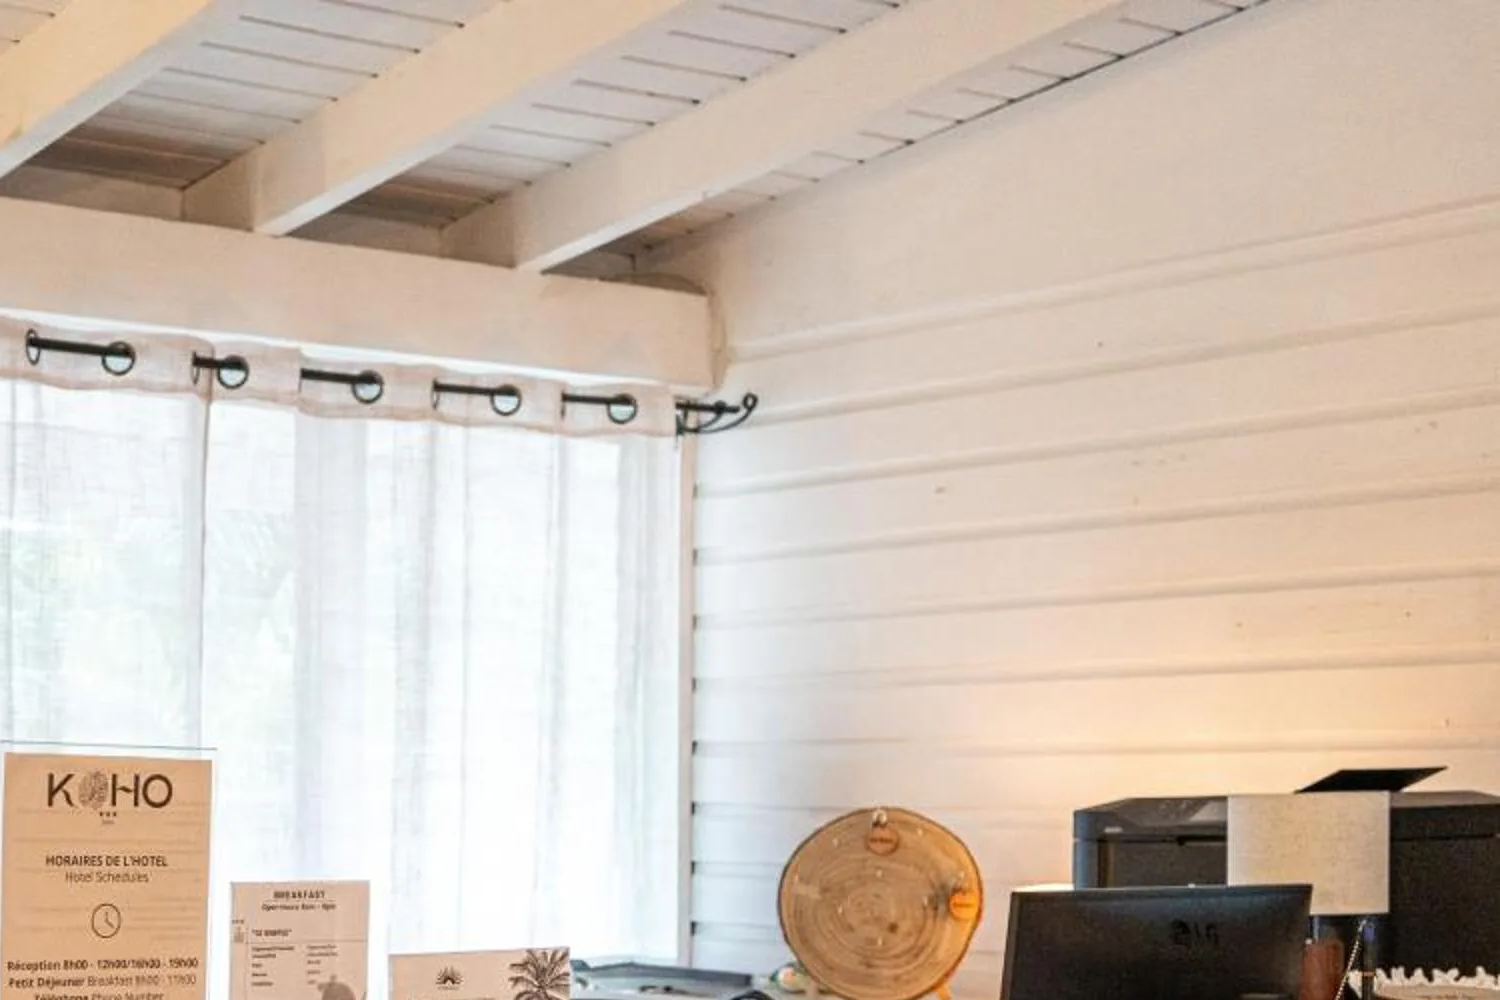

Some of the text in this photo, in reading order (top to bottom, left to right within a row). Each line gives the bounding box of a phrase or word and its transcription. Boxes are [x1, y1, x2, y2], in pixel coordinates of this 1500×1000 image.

[47, 770, 174, 809] KOHO
[45, 854, 168, 867] HORAIRES DE L'HOTEL
[65, 871, 150, 883] Hotel Schedules
[7, 959, 61, 973] Réception
[63, 959, 89, 970] 8h00
[8, 977, 34, 989] Petit
[37, 976, 84, 990] Déjeuner
[87, 974, 133, 987] Breakfast
